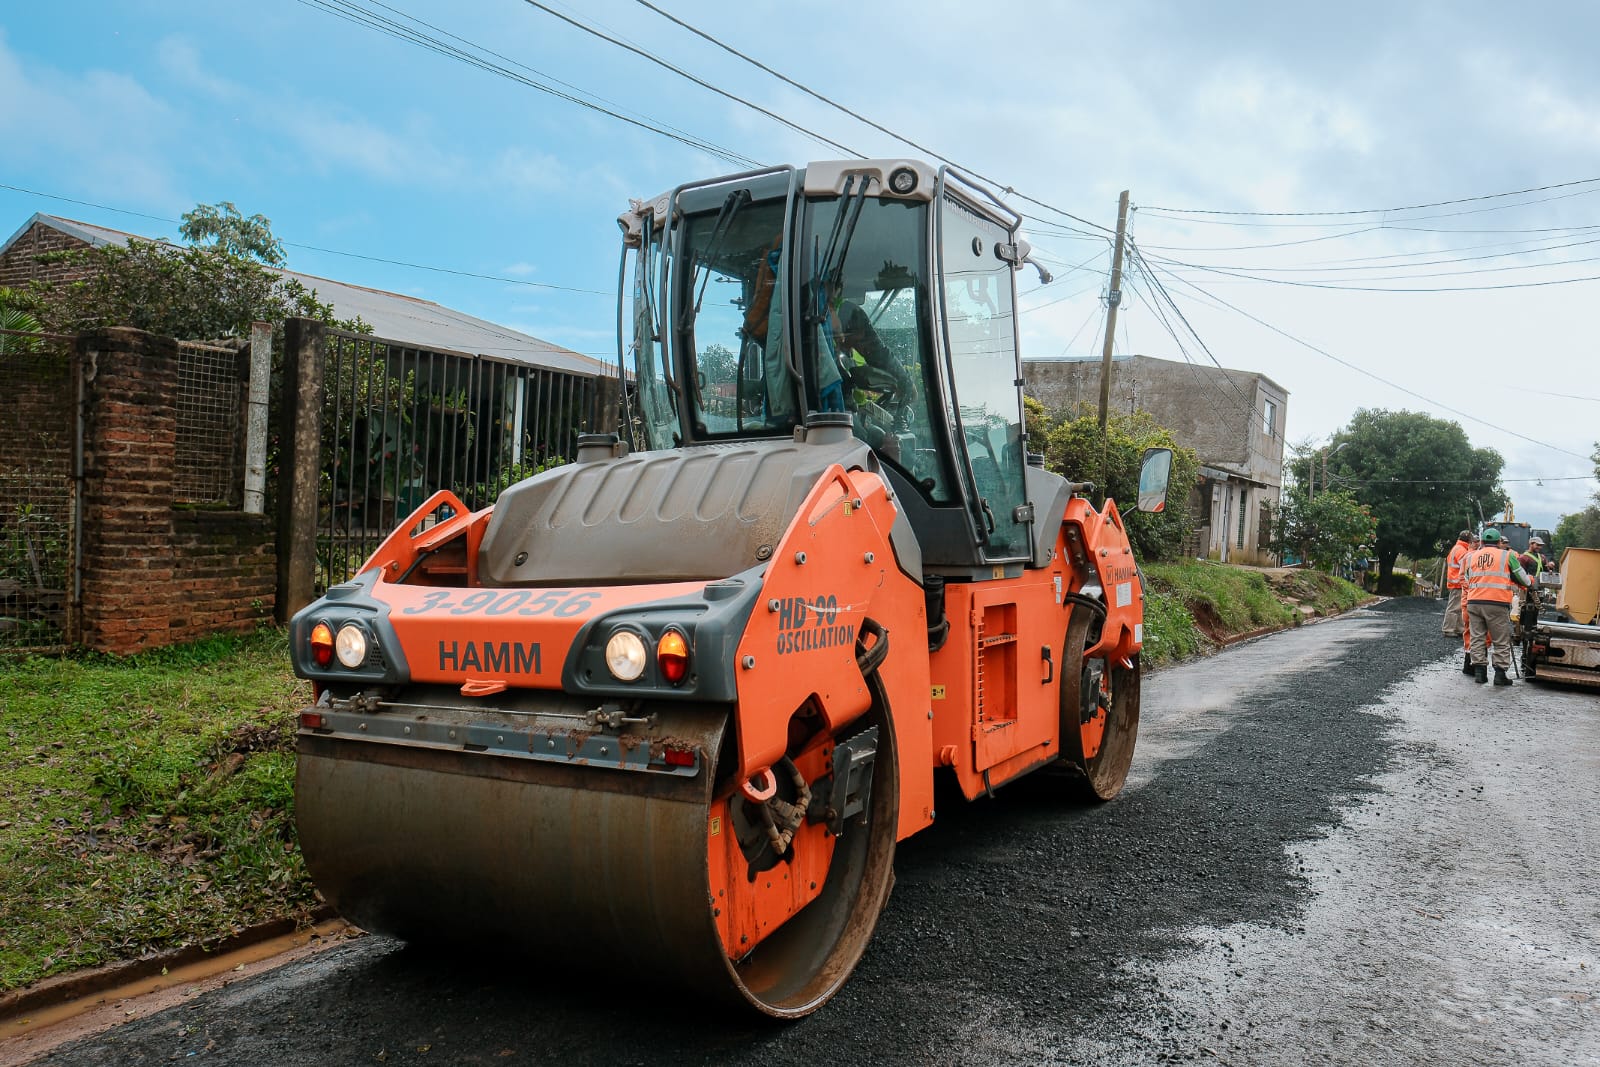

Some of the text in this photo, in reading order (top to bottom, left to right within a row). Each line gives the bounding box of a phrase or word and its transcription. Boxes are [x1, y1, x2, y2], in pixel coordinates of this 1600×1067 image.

[403, 591, 602, 617] 3-9056
[777, 625, 854, 655] OSCILLATION
[439, 640, 541, 674] HAMM
